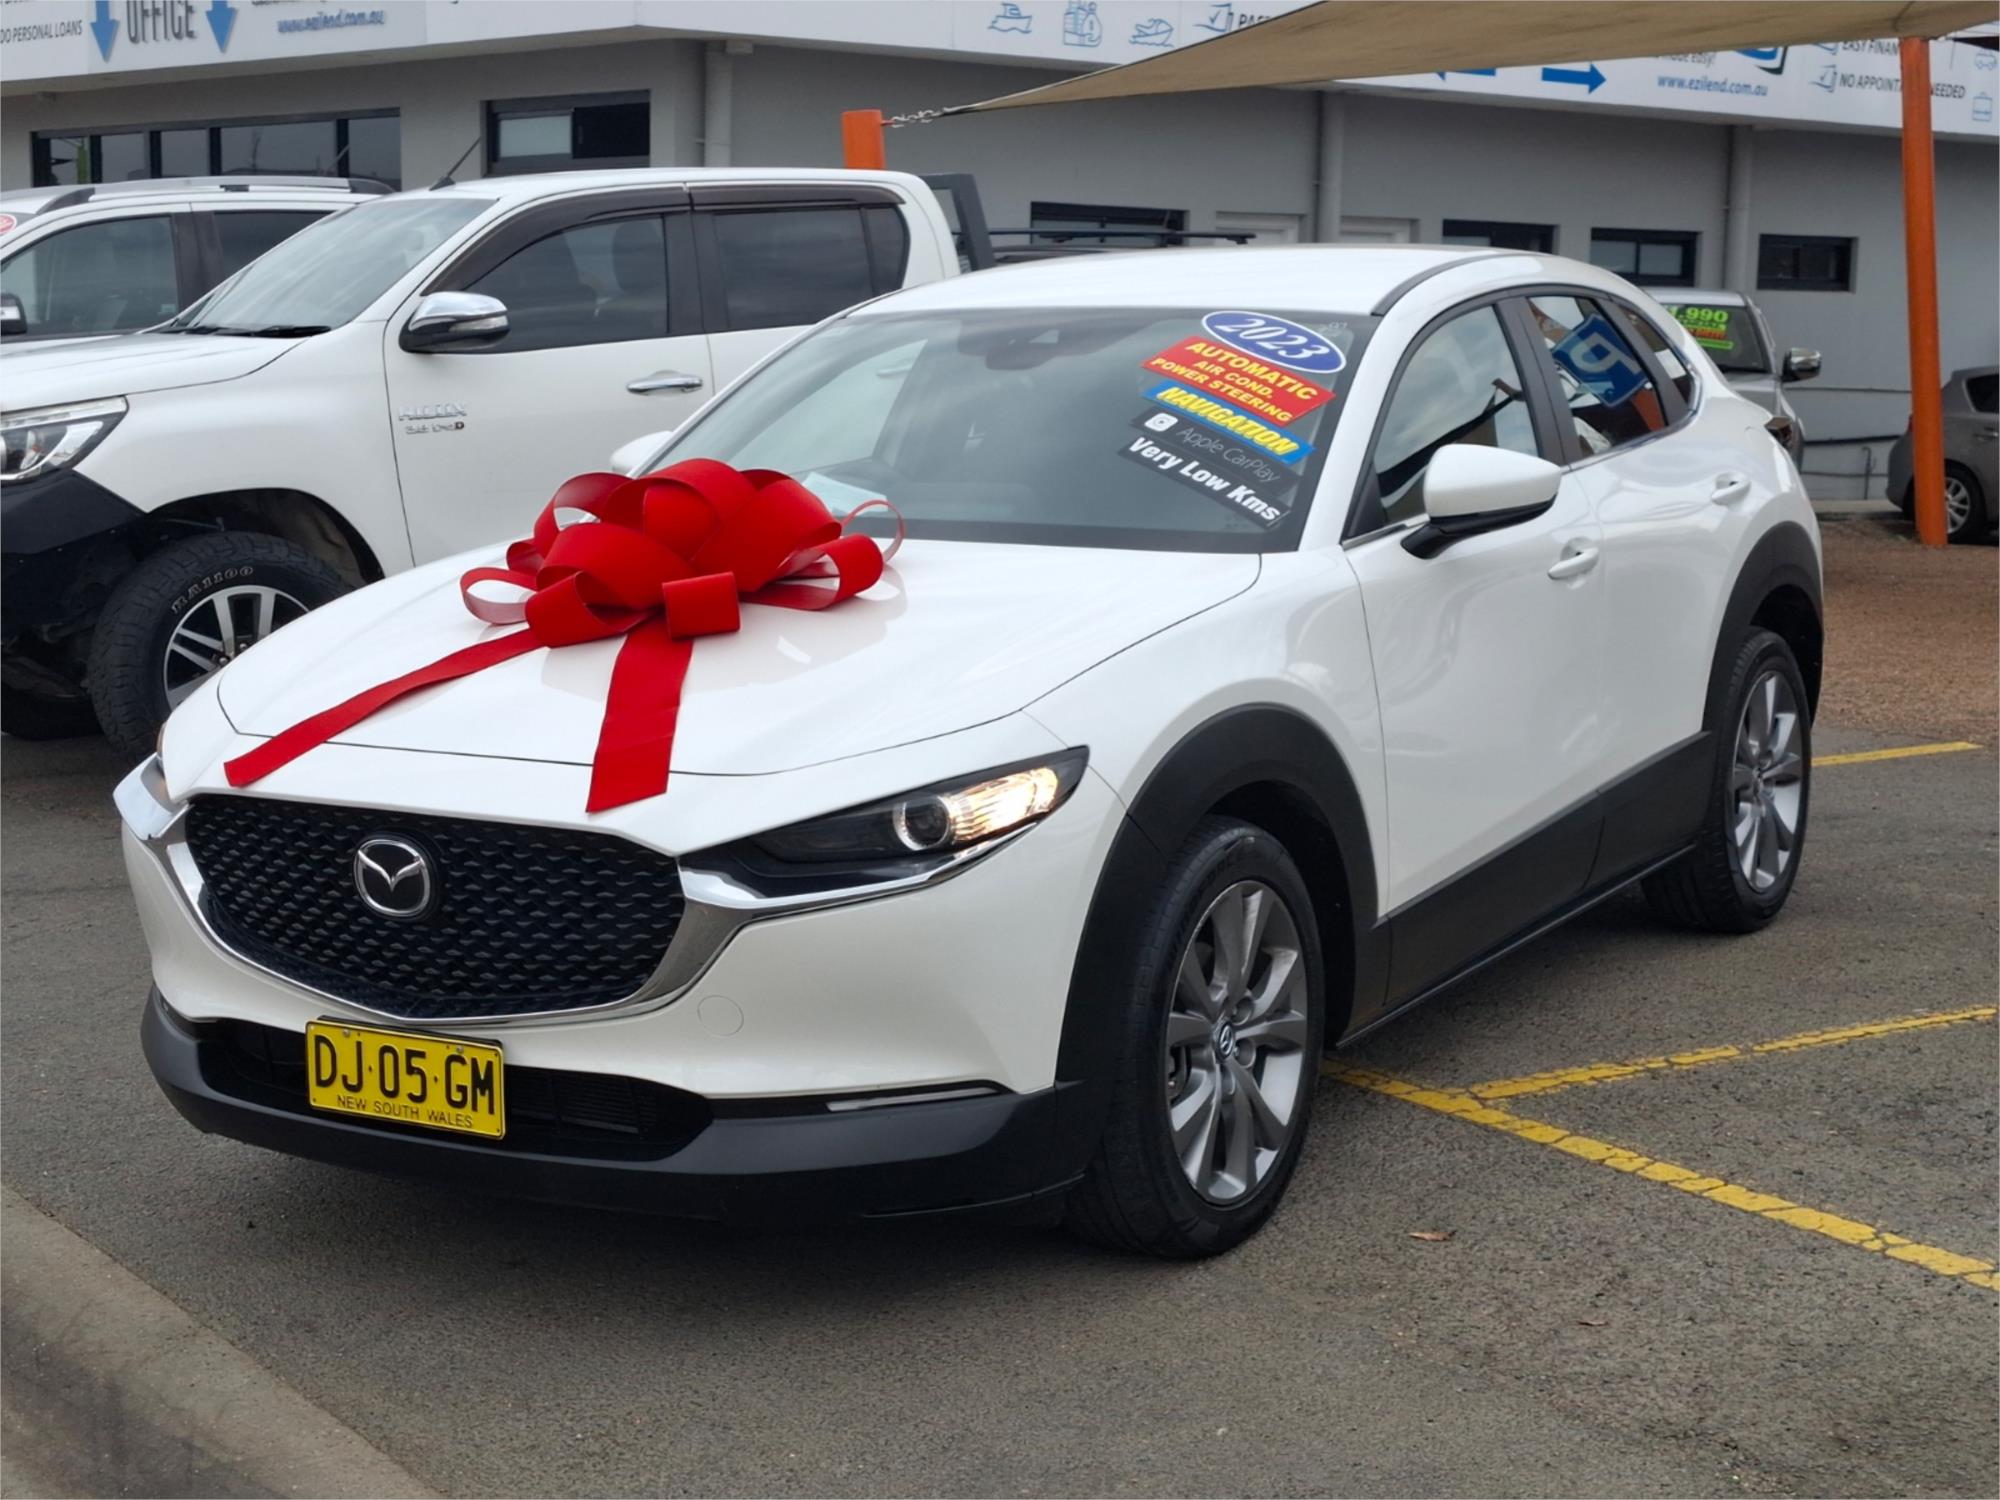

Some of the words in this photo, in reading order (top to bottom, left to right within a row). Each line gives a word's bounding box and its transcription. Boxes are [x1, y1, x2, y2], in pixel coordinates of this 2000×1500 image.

[12, 24, 53, 43] PERSONAL
[54, 20, 83, 38] LOANS
[126, 0, 197, 44] OFFICE
[1657, 75, 1769, 97] www.ezilend.com.au
[1839, 73, 1856, 87] NO
[1857, 74, 1902, 92] APPOINT
[1214, 318, 1330, 359] 2023
[1151, 358, 1207, 384] POWER
[1209, 380, 1293, 423] STEERING
[1186, 342, 1318, 400] AUTOMATIC
[1193, 361, 1222, 376] AIR
[1225, 370, 1273, 399] COND.
[1156, 387, 1299, 456] NAVIGATION
[1177, 428, 1224, 455] Apple
[1222, 448, 1281, 482] CarPlay
[1129, 437, 1180, 469] Very
[1179, 461, 1230, 490] Low
[1227, 485, 1280, 521] Kms
[337, 1095, 367, 1110] NEW
[373, 1100, 420, 1121] SOUTH
[427, 1109, 473, 1129] WALES
